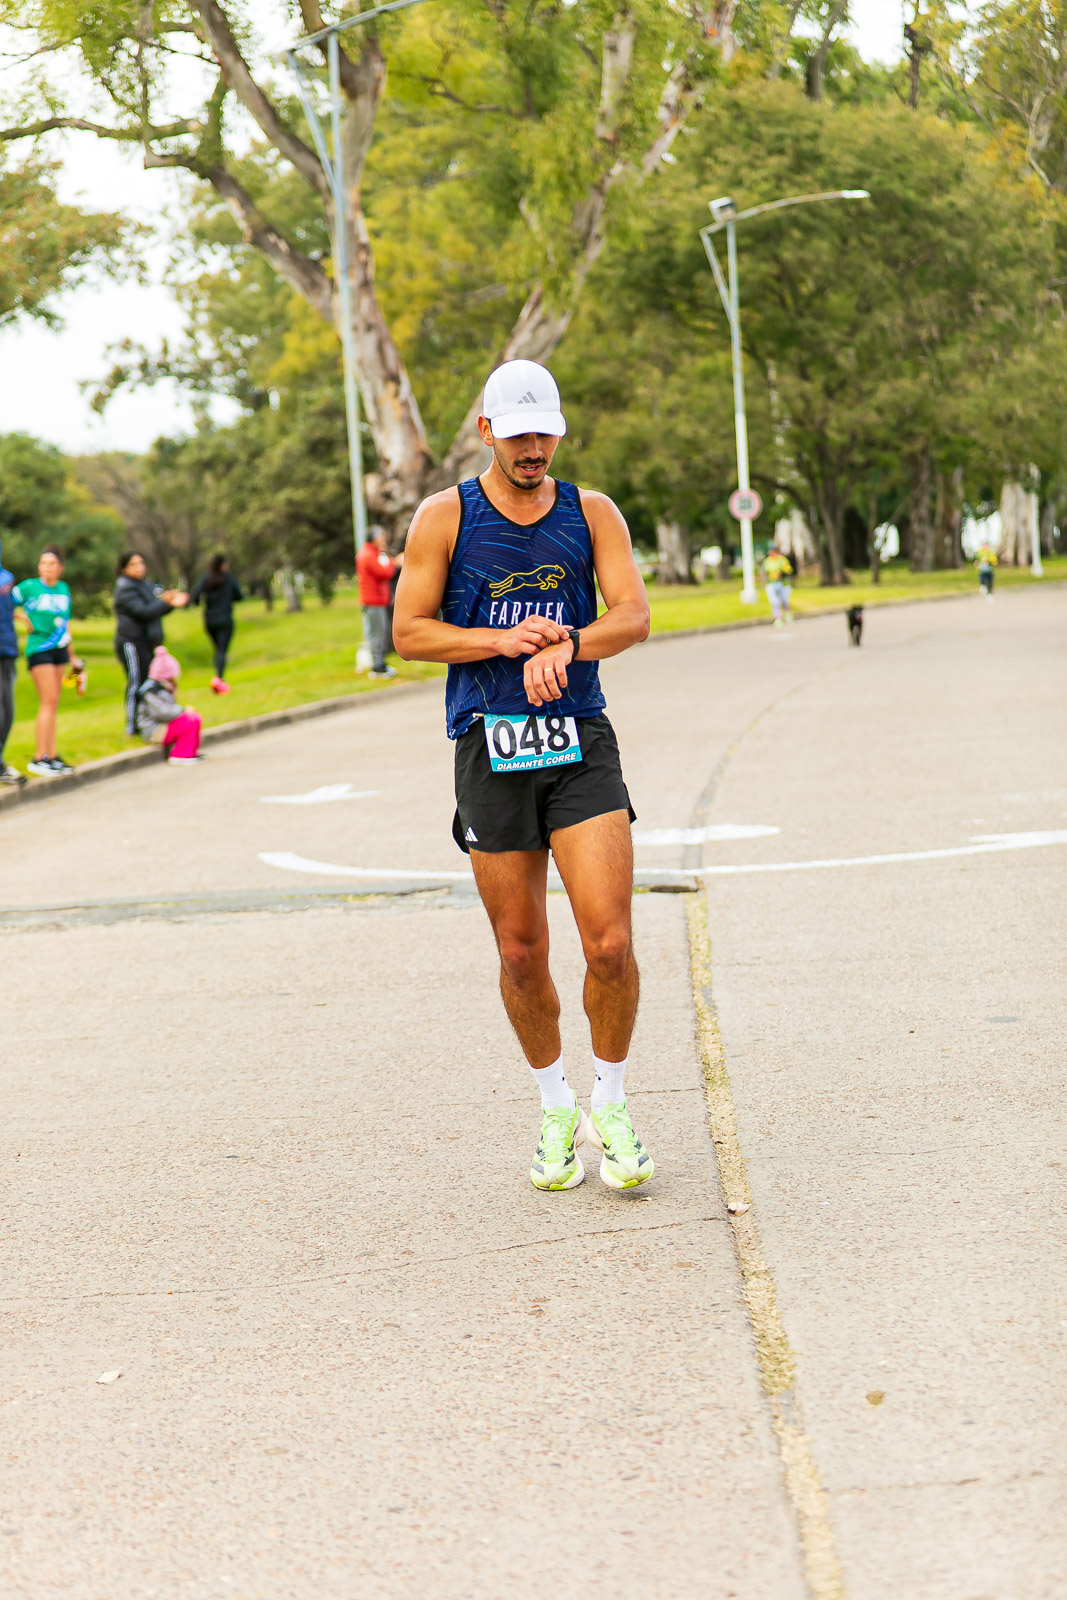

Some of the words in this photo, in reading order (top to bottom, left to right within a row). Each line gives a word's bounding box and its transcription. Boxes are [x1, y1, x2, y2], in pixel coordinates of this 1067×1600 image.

[493, 715, 570, 760] 048
[497, 759, 544, 770] DIAMANTE
[546, 753, 576, 765] CORRE
